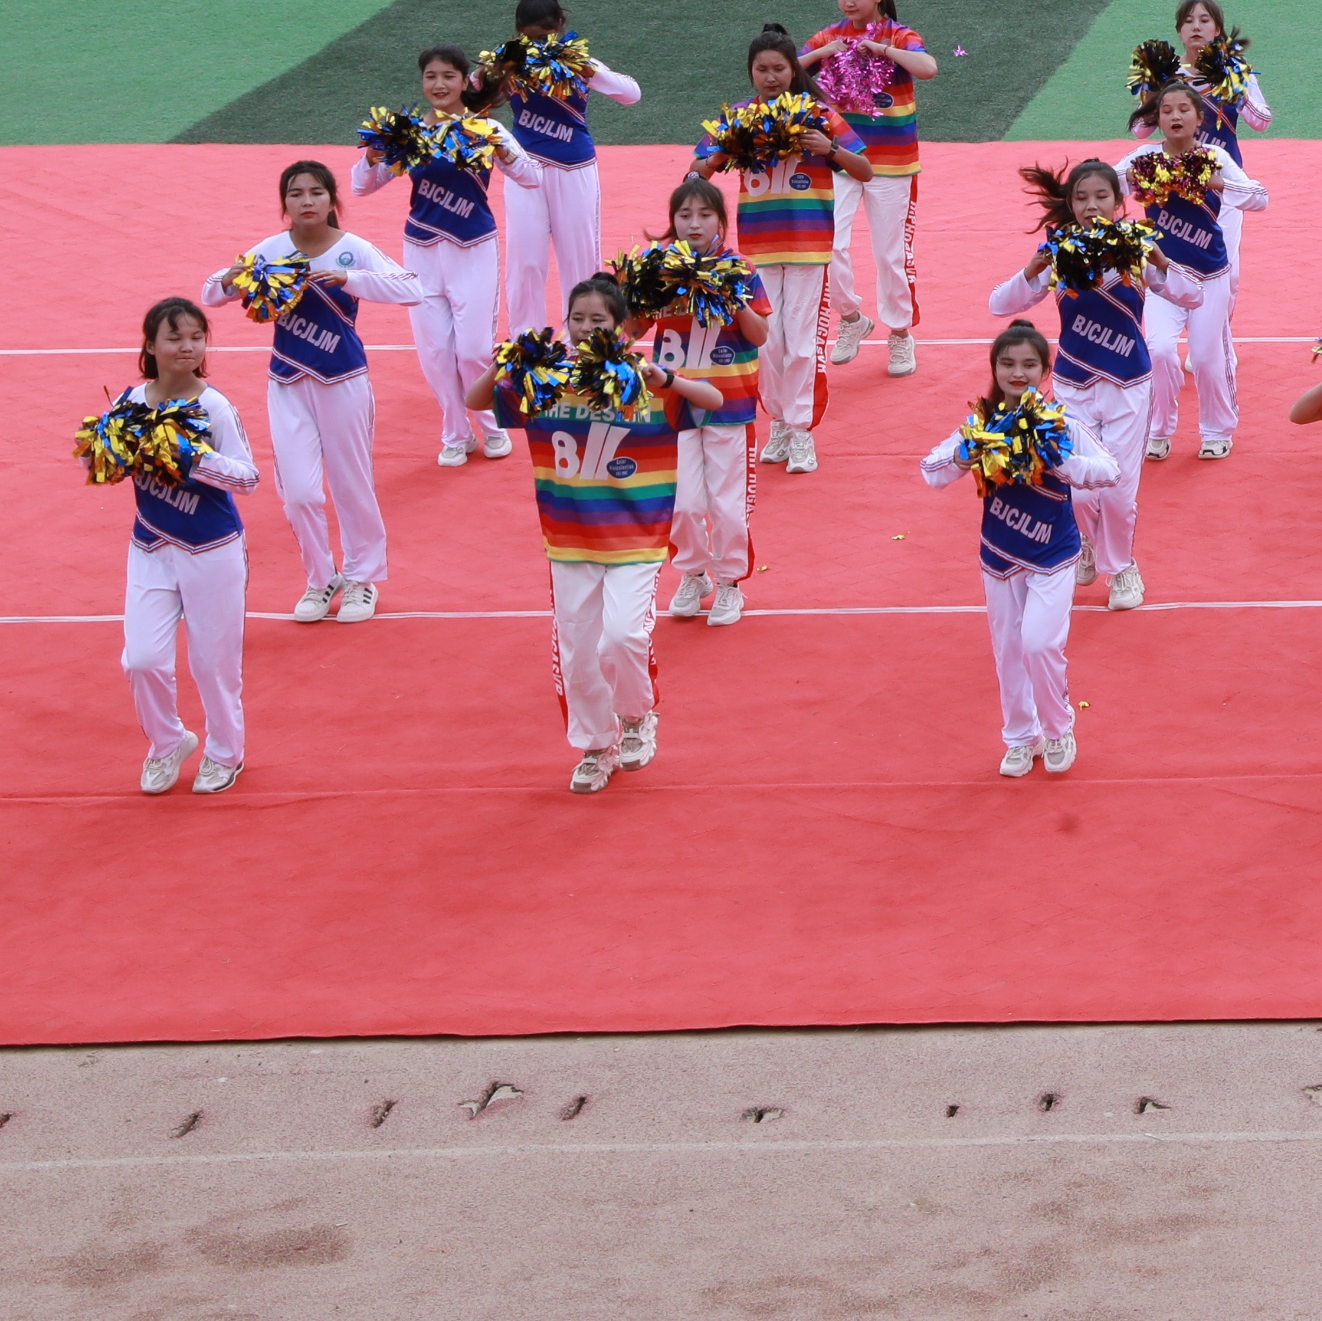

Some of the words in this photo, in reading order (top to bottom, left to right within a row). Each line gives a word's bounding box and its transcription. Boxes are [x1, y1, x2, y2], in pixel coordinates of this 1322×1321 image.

[518, 109, 574, 143] BJCJLJM
[418, 179, 475, 219] BJCJLJM
[1157, 210, 1213, 249] BJCJLJM
[1072, 314, 1136, 358] BJCJLJM
[990, 496, 1053, 544] BJCJLJM
